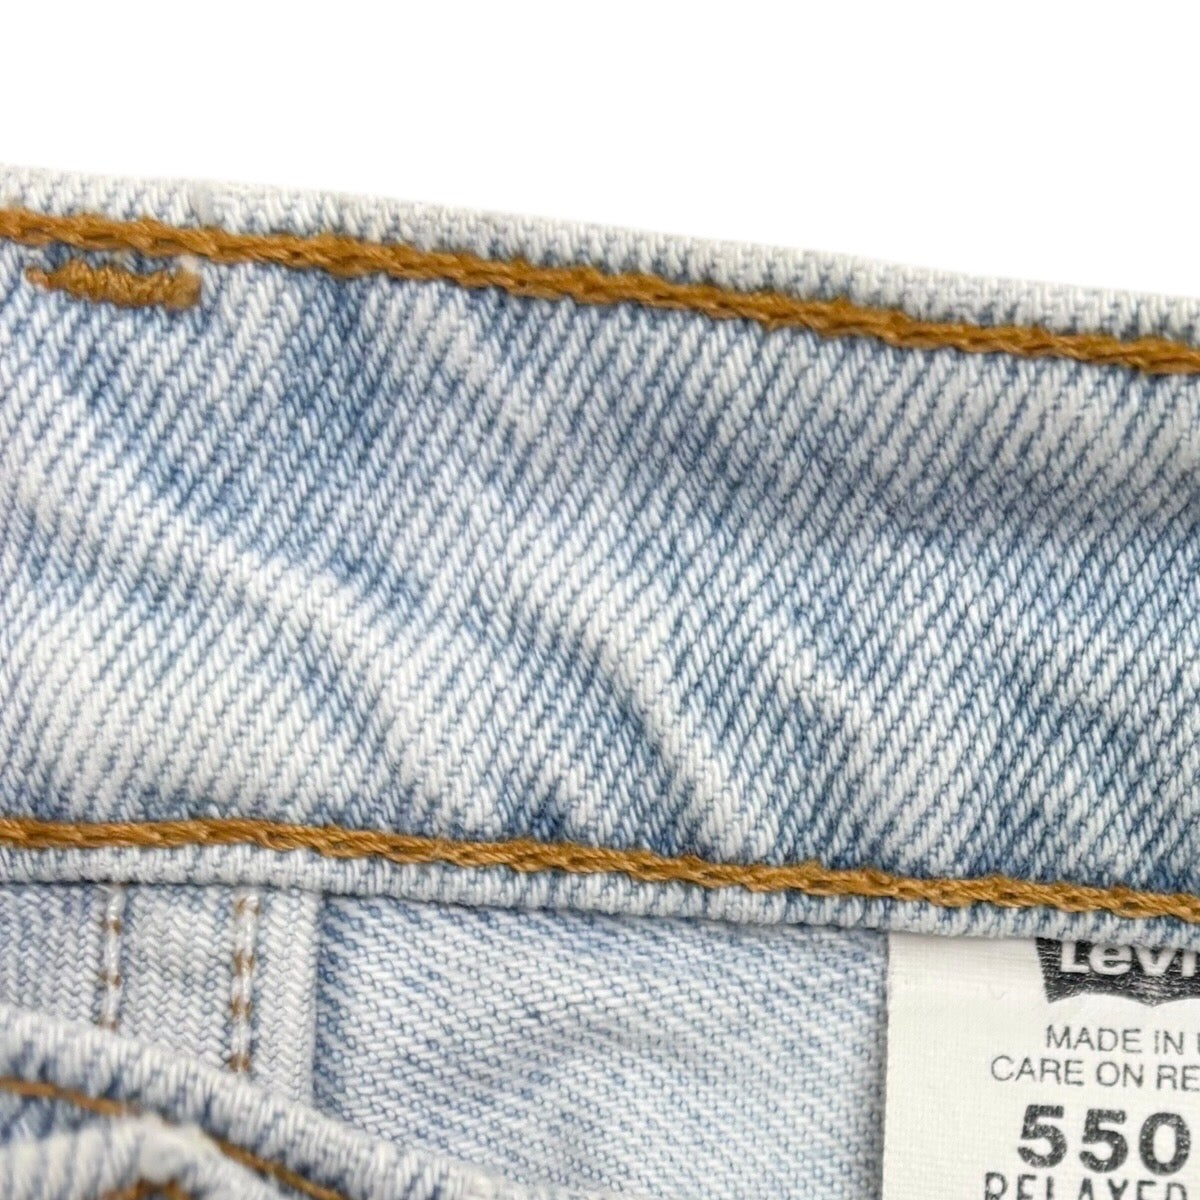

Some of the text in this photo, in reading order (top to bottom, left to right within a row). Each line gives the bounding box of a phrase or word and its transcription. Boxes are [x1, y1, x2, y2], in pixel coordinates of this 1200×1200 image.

[1045, 1023, 1143, 1054] MADE
[1153, 1029, 1185, 1056] IN
[990, 1054, 1085, 1087] CARE
[1095, 1060, 1145, 1089] ON
